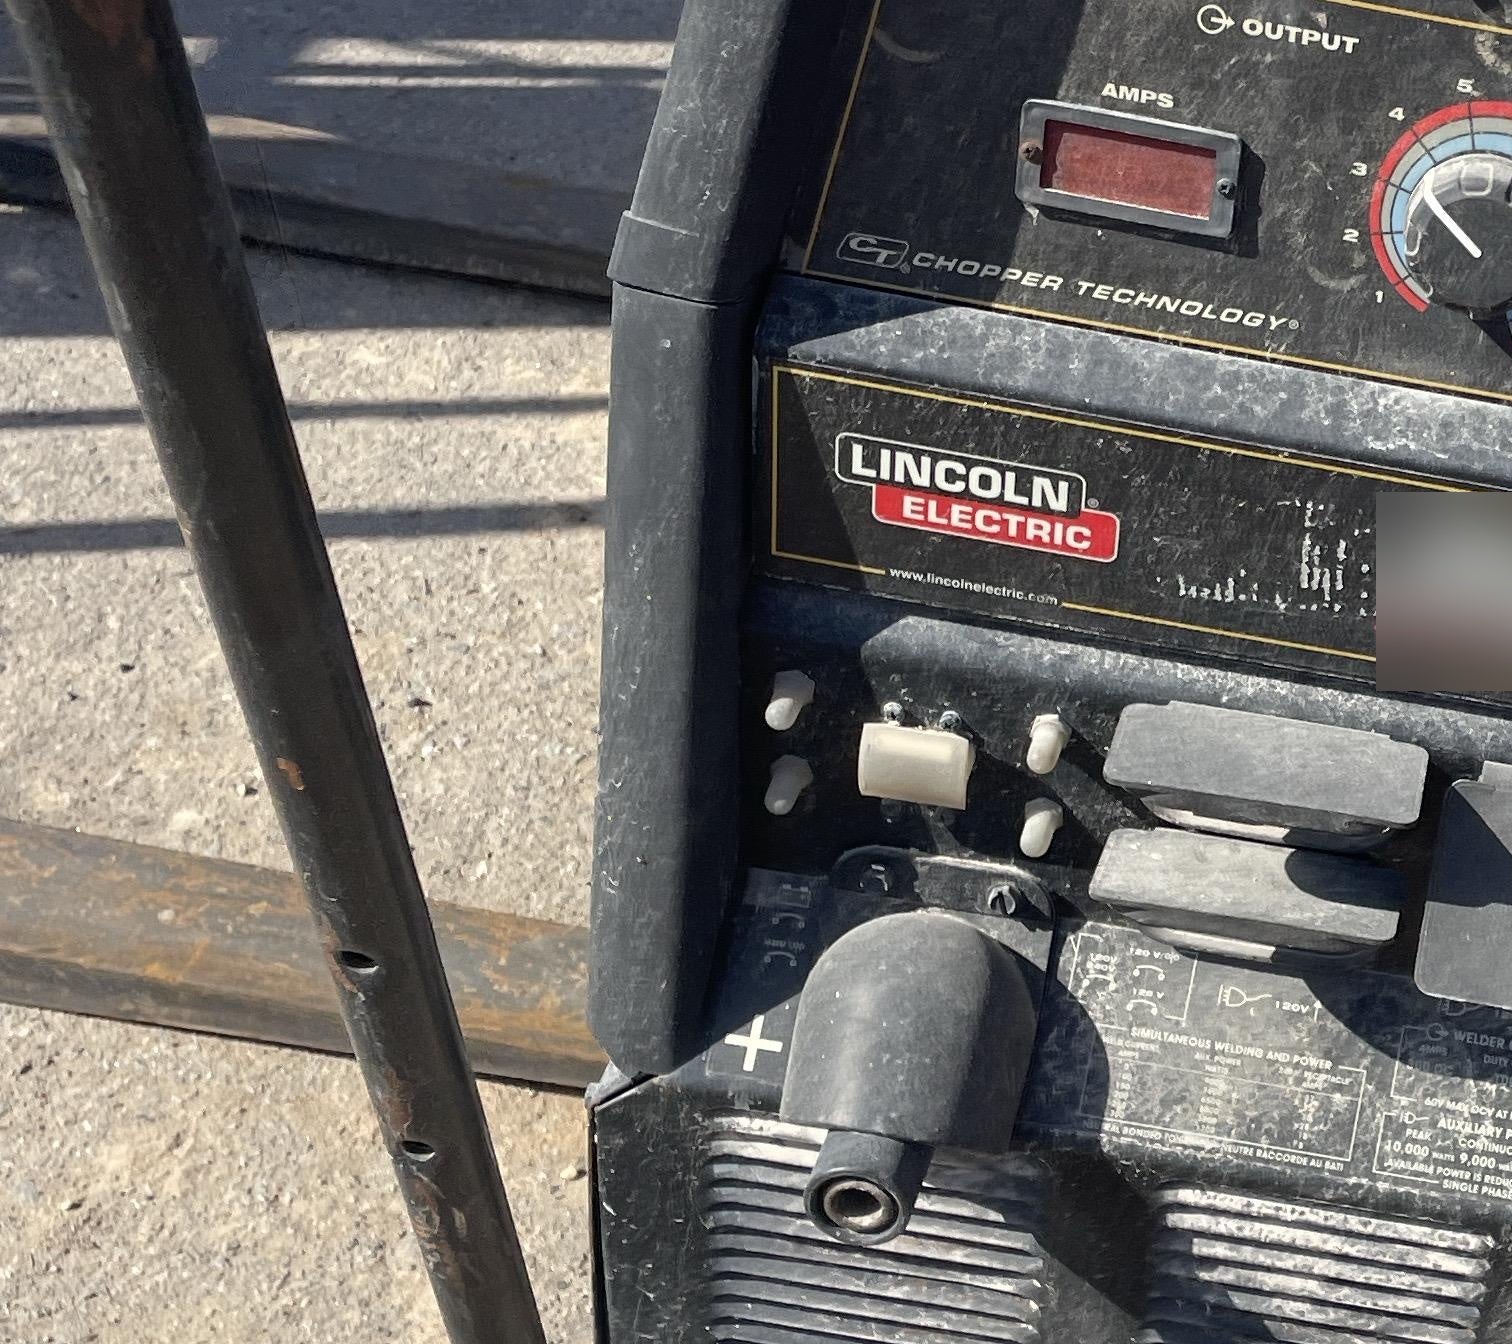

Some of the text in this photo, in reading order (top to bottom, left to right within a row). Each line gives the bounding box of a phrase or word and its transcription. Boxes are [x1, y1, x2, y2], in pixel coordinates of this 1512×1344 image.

[1242, 17, 1360, 54] OUTPUT
[1457, 78, 1473, 94] 5
[1101, 82, 1175, 109] AMPS
[1388, 107, 1405, 122] 4
[1352, 161, 1367, 176] 3
[1343, 228, 1359, 242] 2
[912, 252, 1289, 331] CHOPPER TECHNOLOGY
[1375, 290, 1383, 304] 1
[850, 442, 1070, 513] LINCOLN
[902, 494, 1092, 552] ELECTRIC
[889, 566, 1059, 607] www.lincolnelectric.com
[1275, 1000, 1309, 1014] 120V
[1130, 1026, 1212, 1049] SIMULTANEOUS
[1214, 1041, 1264, 1058] WELDING
[1266, 1051, 1290, 1063] AND
[1293, 1056, 1334, 1070] POWER
[1453, 1031, 1504, 1049] WELDER
[1483, 1055, 1508, 1068] DUTY
[1424, 1097, 1445, 1107] 60V
[1495, 1109, 1509, 1120] AT
[1406, 1128, 1432, 1141] PEAK
[1437, 1116, 1503, 1139] AUXILIARY
[1256, 1148, 1308, 1165] RACCORDE
[1309, 1159, 1322, 1168] AU
[1460, 1152, 1496, 1169] 9,000
[1437, 1166, 1472, 1180] POWER
[1473, 1172, 1482, 1182] IS
[1443, 1179, 1480, 1194] SINGLE
